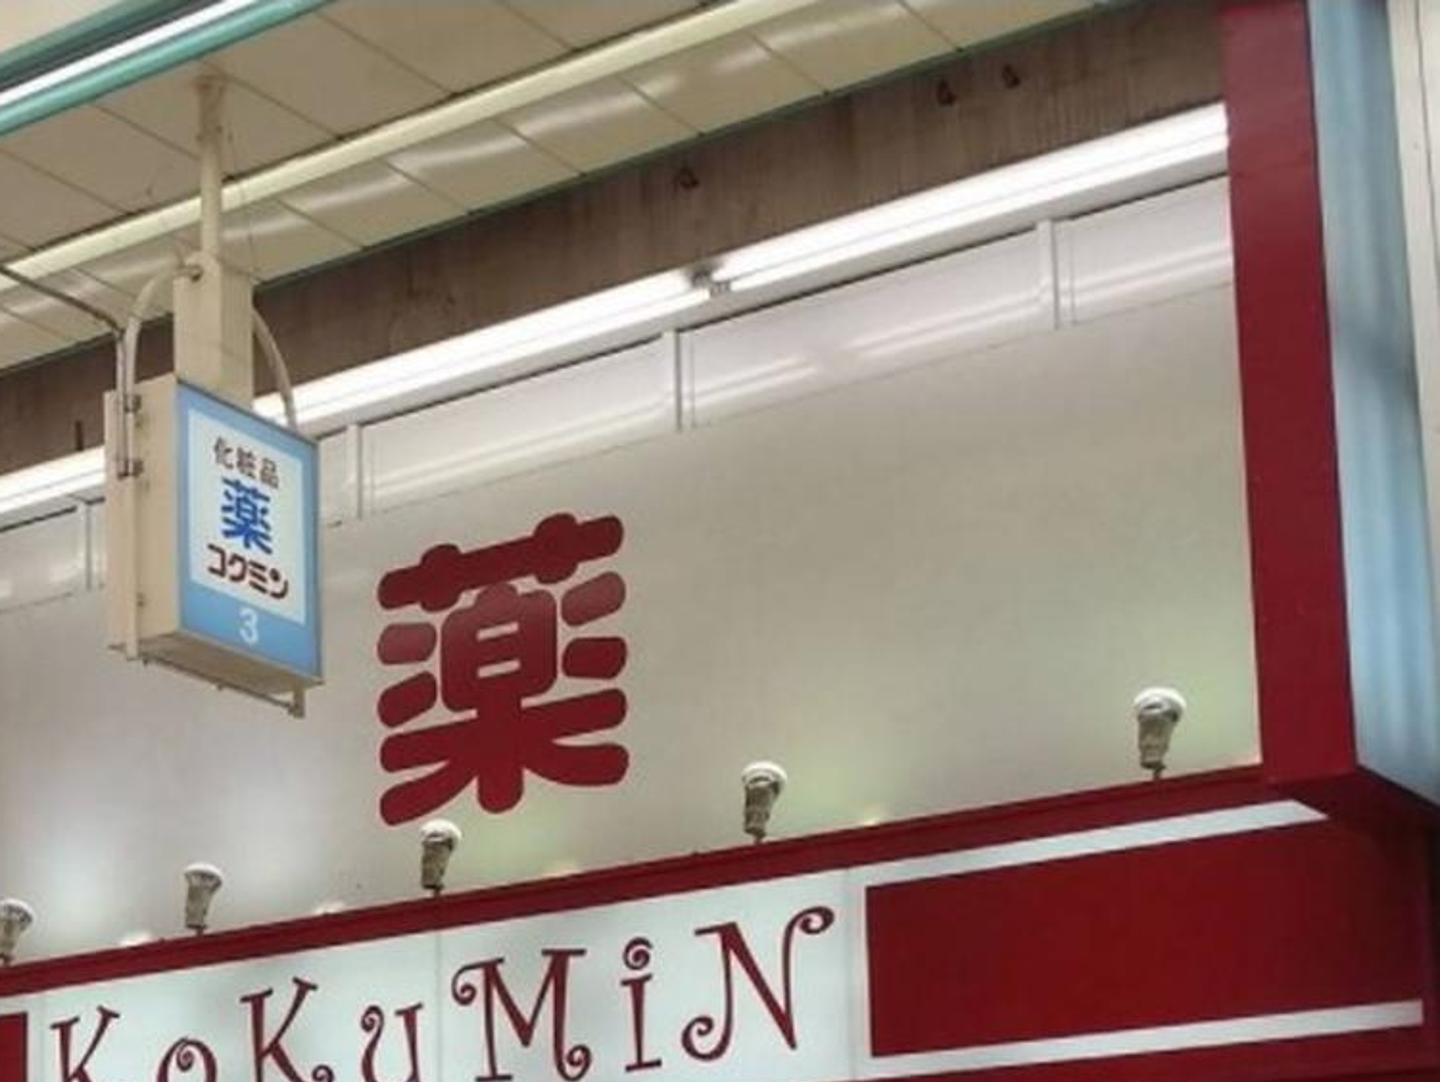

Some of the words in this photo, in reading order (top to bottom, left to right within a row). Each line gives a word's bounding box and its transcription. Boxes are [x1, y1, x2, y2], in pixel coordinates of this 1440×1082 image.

[220, 475, 274, 555] 薬
[207, 543, 289, 600] コクミン
[239, 608, 259, 645] 3
[377, 513, 629, 826] 薬
